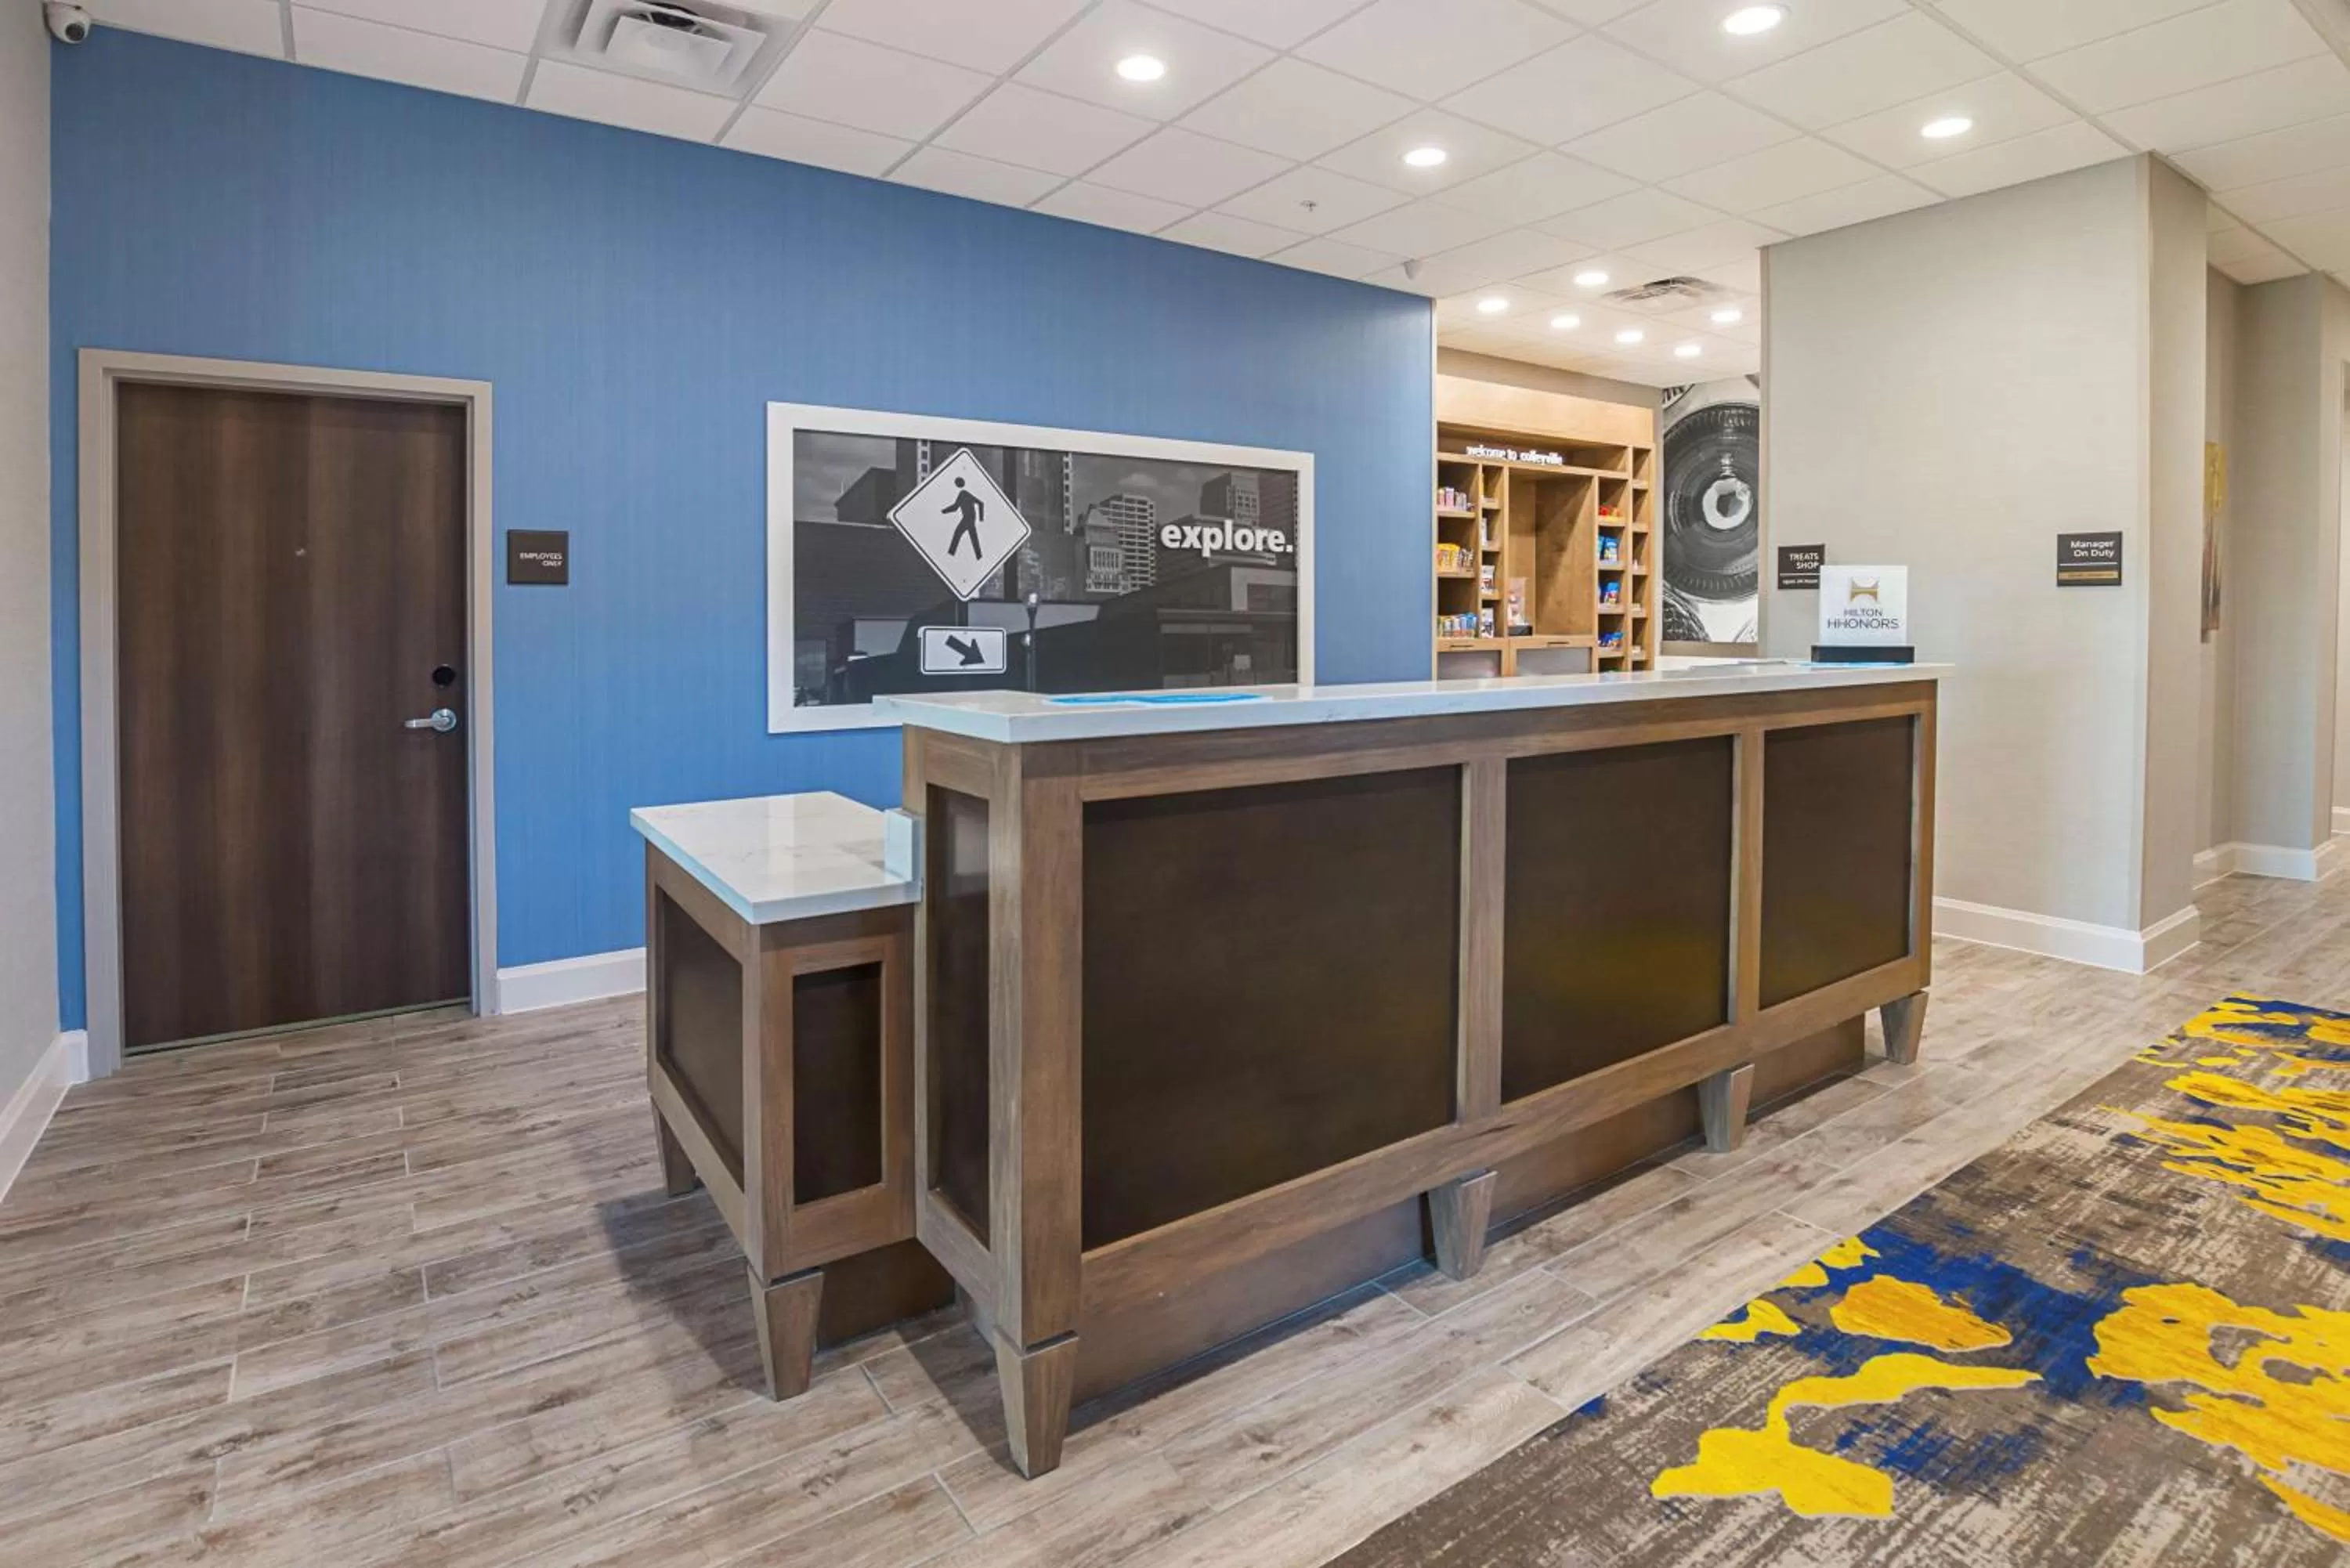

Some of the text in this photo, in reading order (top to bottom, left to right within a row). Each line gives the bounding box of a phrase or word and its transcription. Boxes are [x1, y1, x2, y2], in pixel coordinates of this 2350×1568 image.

[1161, 519, 1293, 558] explore.
[2070, 540, 2114, 548] Manager
[1789, 552, 1819, 561] TREATS
[2091, 549, 2115, 558] Duty
[1843, 608, 1883, 617] HILTON
[1827, 618, 1900, 629] HHONORS
